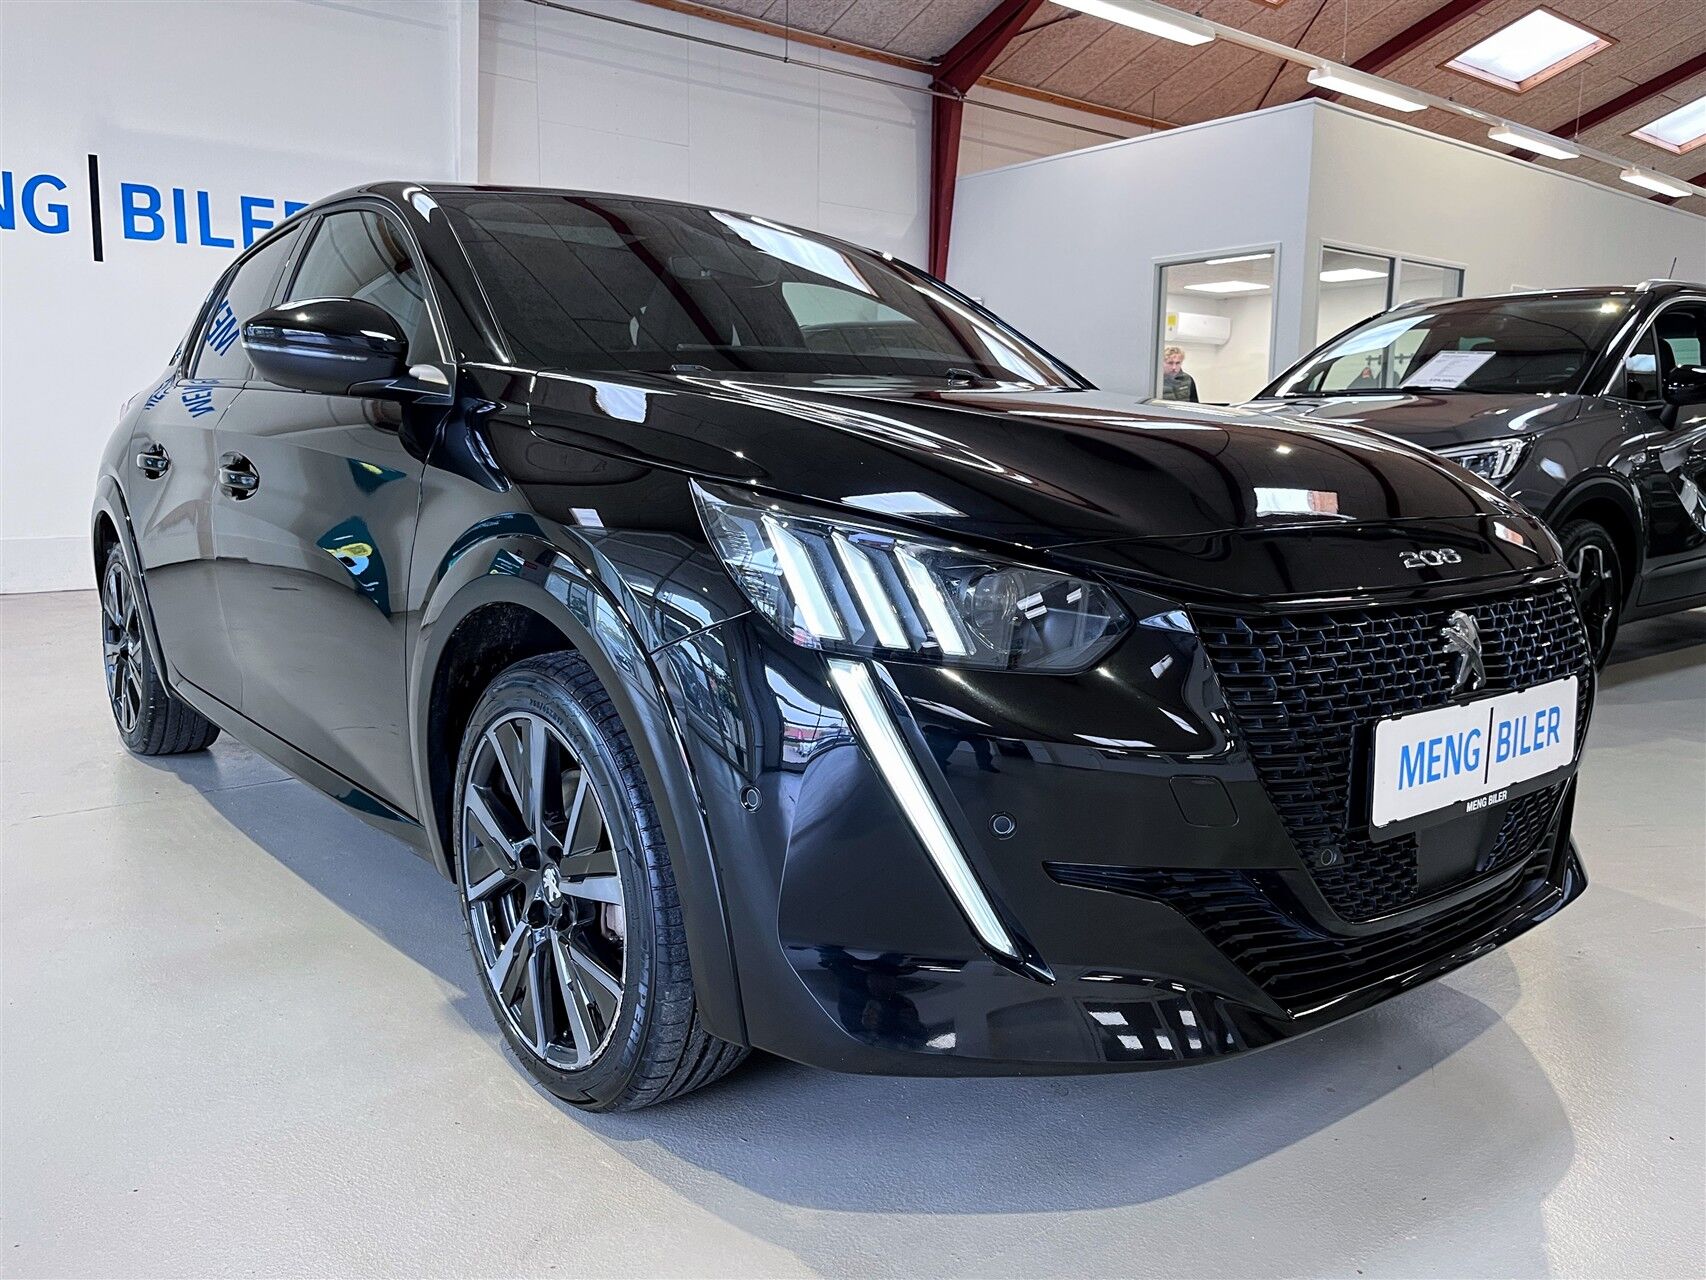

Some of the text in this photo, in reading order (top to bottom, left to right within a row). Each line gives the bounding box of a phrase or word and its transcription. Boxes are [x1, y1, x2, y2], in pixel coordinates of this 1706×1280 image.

[120, 182, 310, 250] BILE
[1399, 548, 1462, 569] 208
[1398, 706, 1561, 791] MENG BILER
[1466, 790, 1508, 813] MENG BILER
